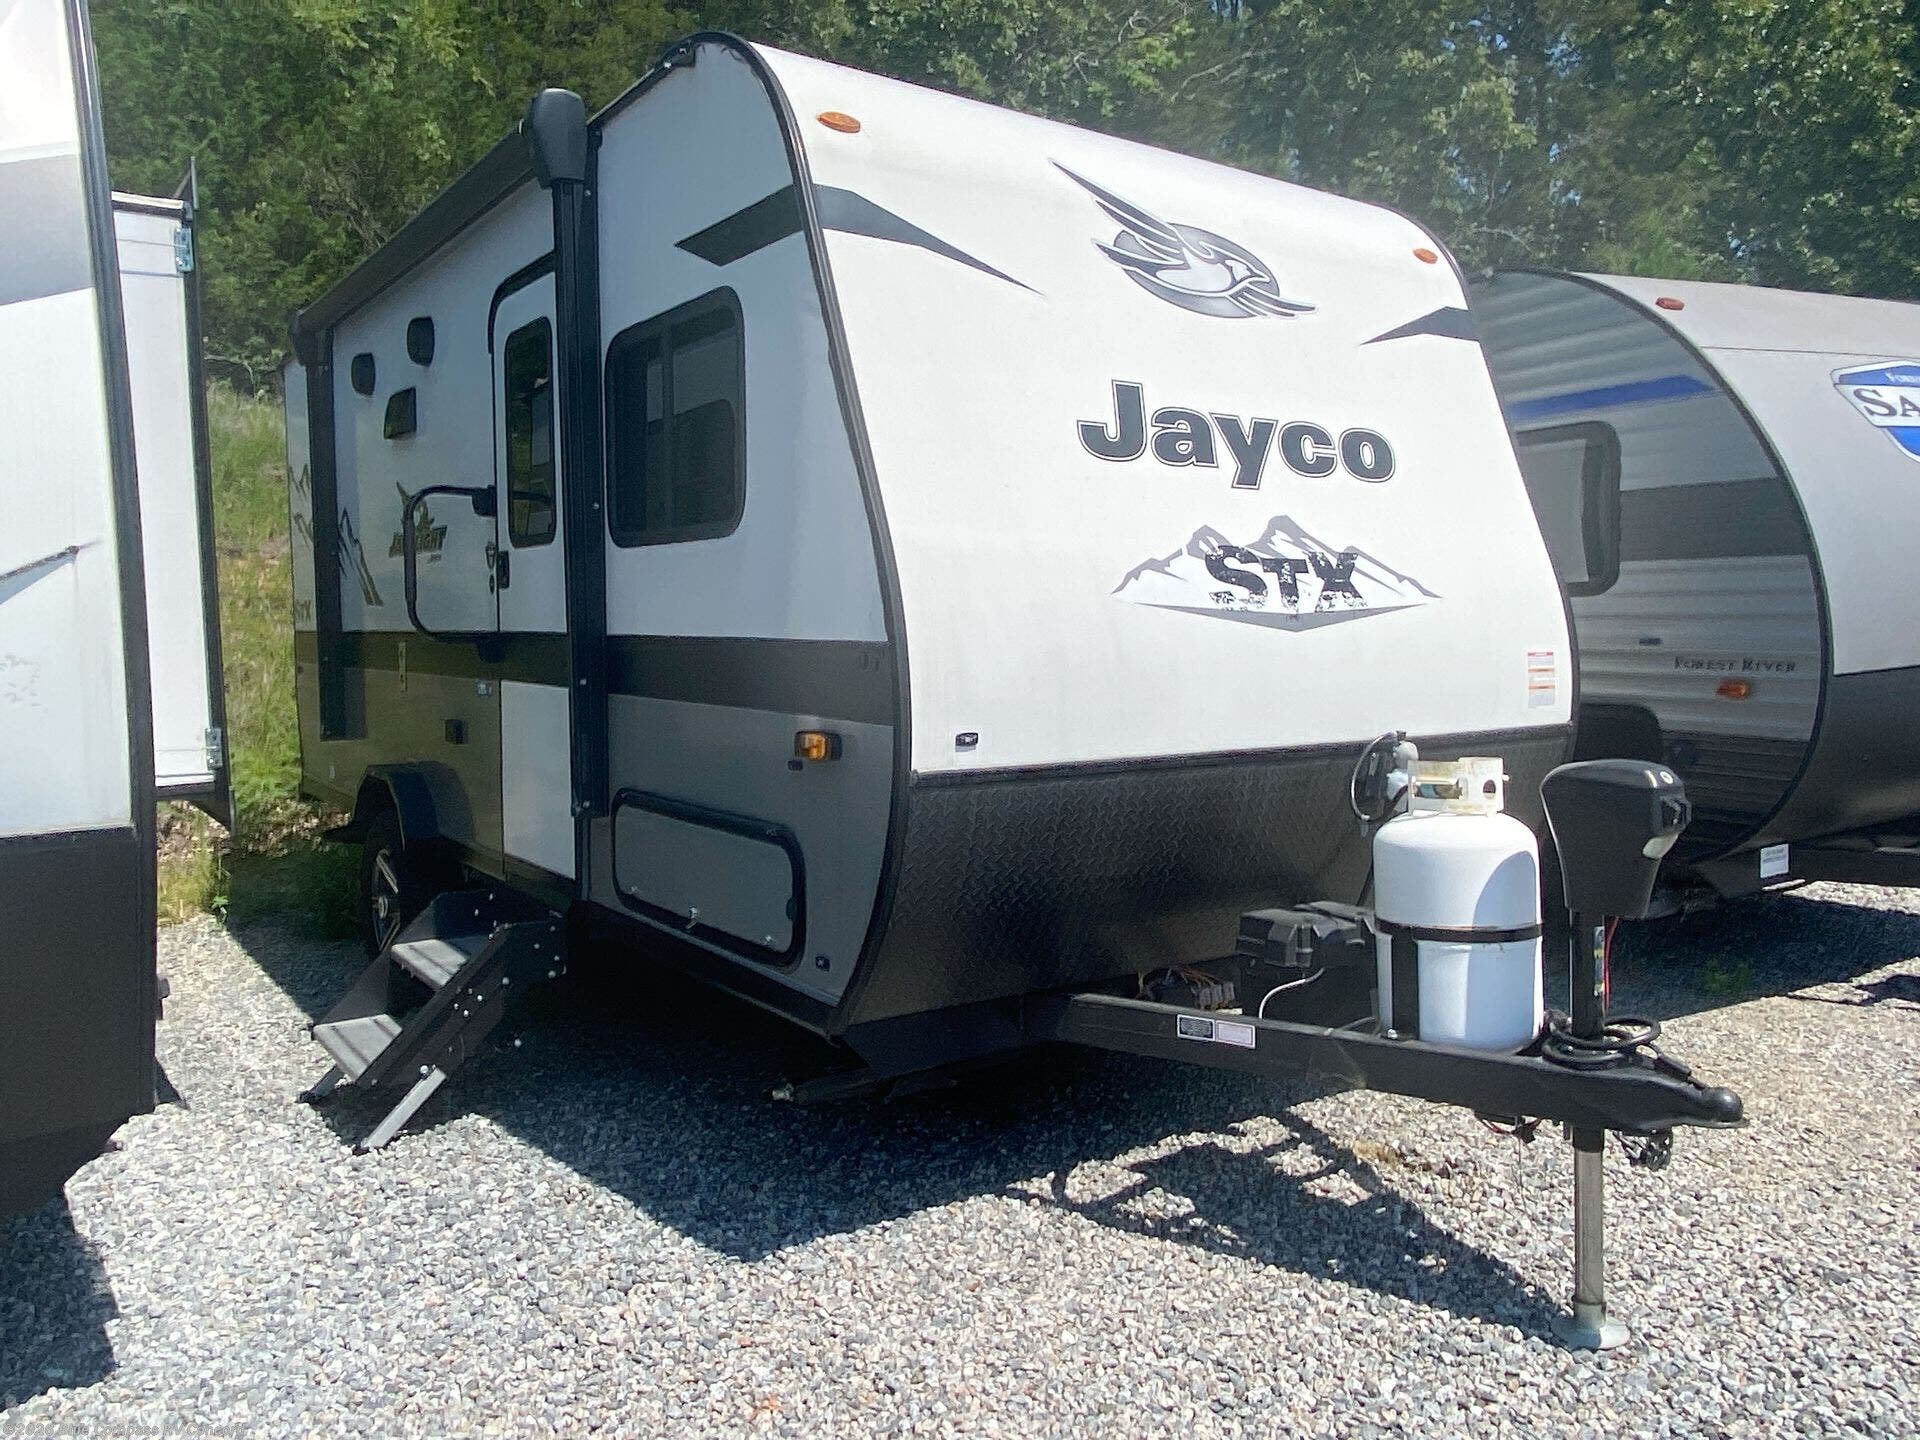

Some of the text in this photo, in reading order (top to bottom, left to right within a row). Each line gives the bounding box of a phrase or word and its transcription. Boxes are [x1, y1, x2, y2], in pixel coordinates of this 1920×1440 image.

[1076, 379, 1397, 491] Jayco
[1205, 545, 1369, 613] STX
[1673, 657, 1796, 672] FOREST RIVER
